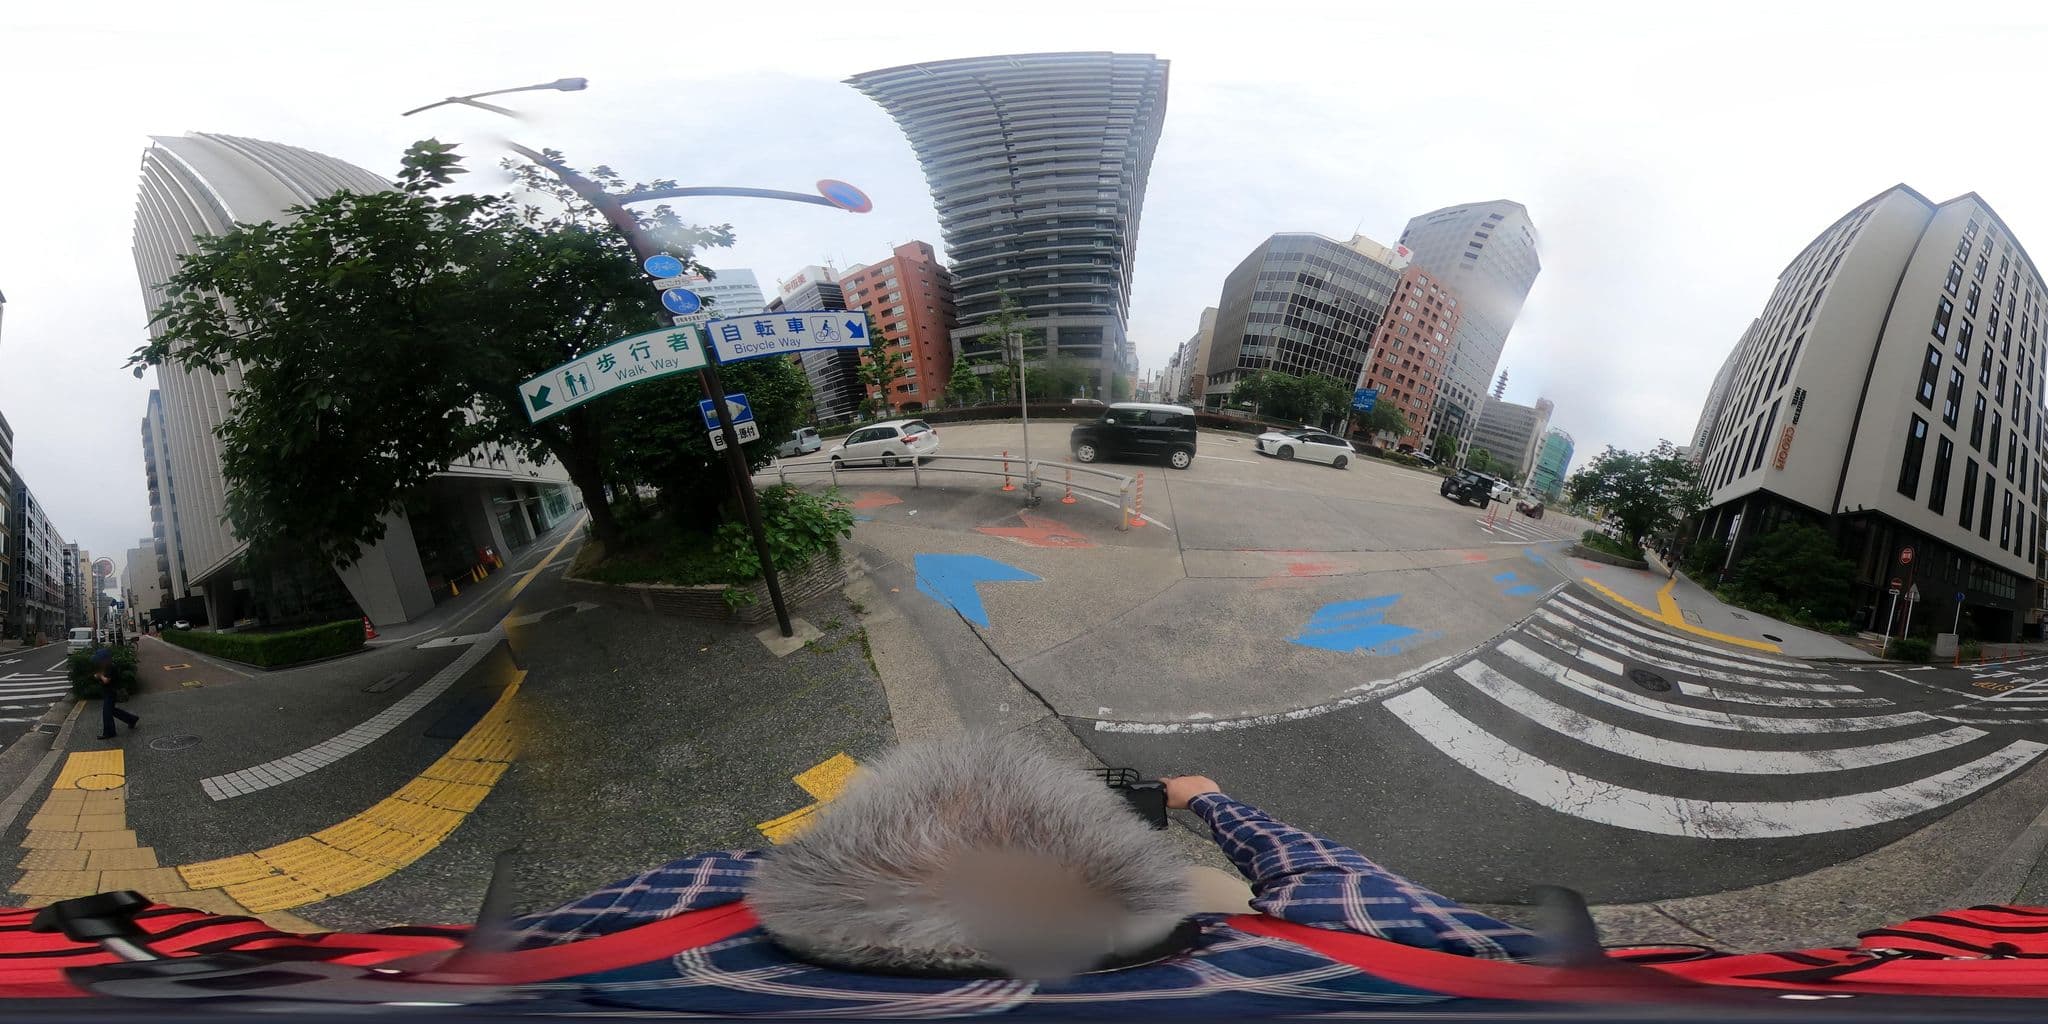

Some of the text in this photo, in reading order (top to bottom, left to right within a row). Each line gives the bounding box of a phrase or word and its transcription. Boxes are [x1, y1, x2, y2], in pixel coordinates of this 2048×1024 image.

[721, 317, 806, 342] 自転車
[596, 333, 689, 373] 歩行者
[734, 337, 801, 354] Bicycle Way
[615, 357, 679, 381] Walk Way
